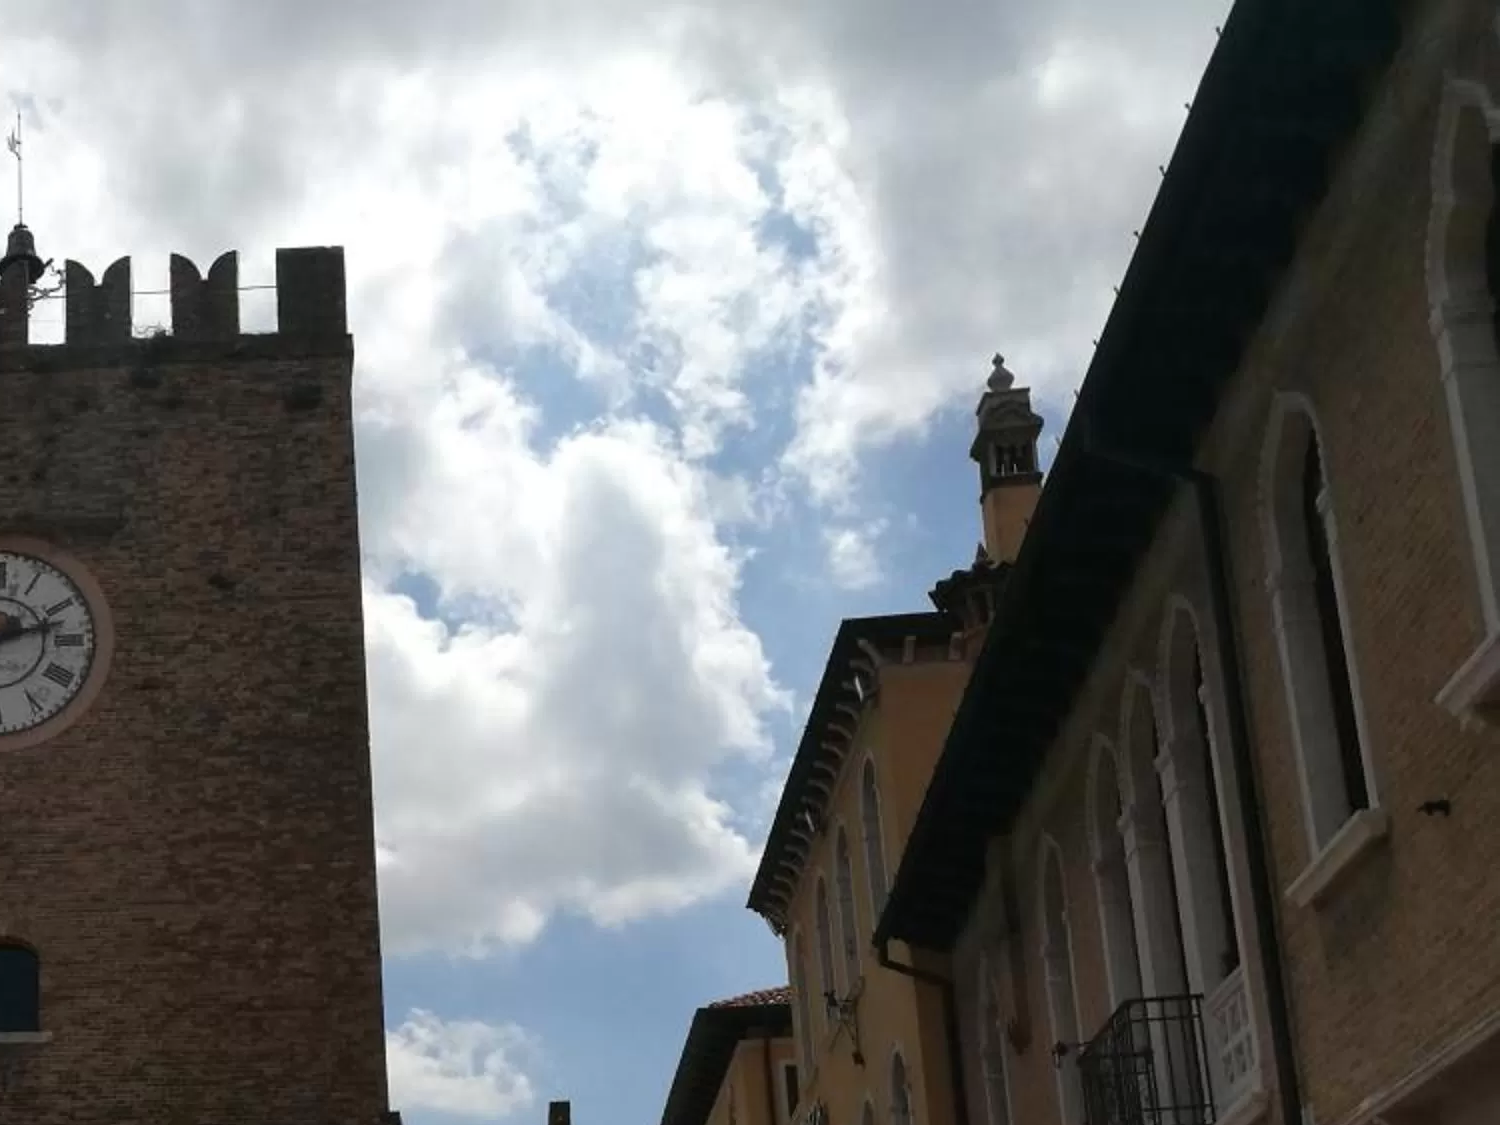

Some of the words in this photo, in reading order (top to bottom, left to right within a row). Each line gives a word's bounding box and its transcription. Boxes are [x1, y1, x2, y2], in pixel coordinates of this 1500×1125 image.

[45, 598, 73, 617] II
[55, 634, 85, 647] III
[24, 689, 44, 717] V
